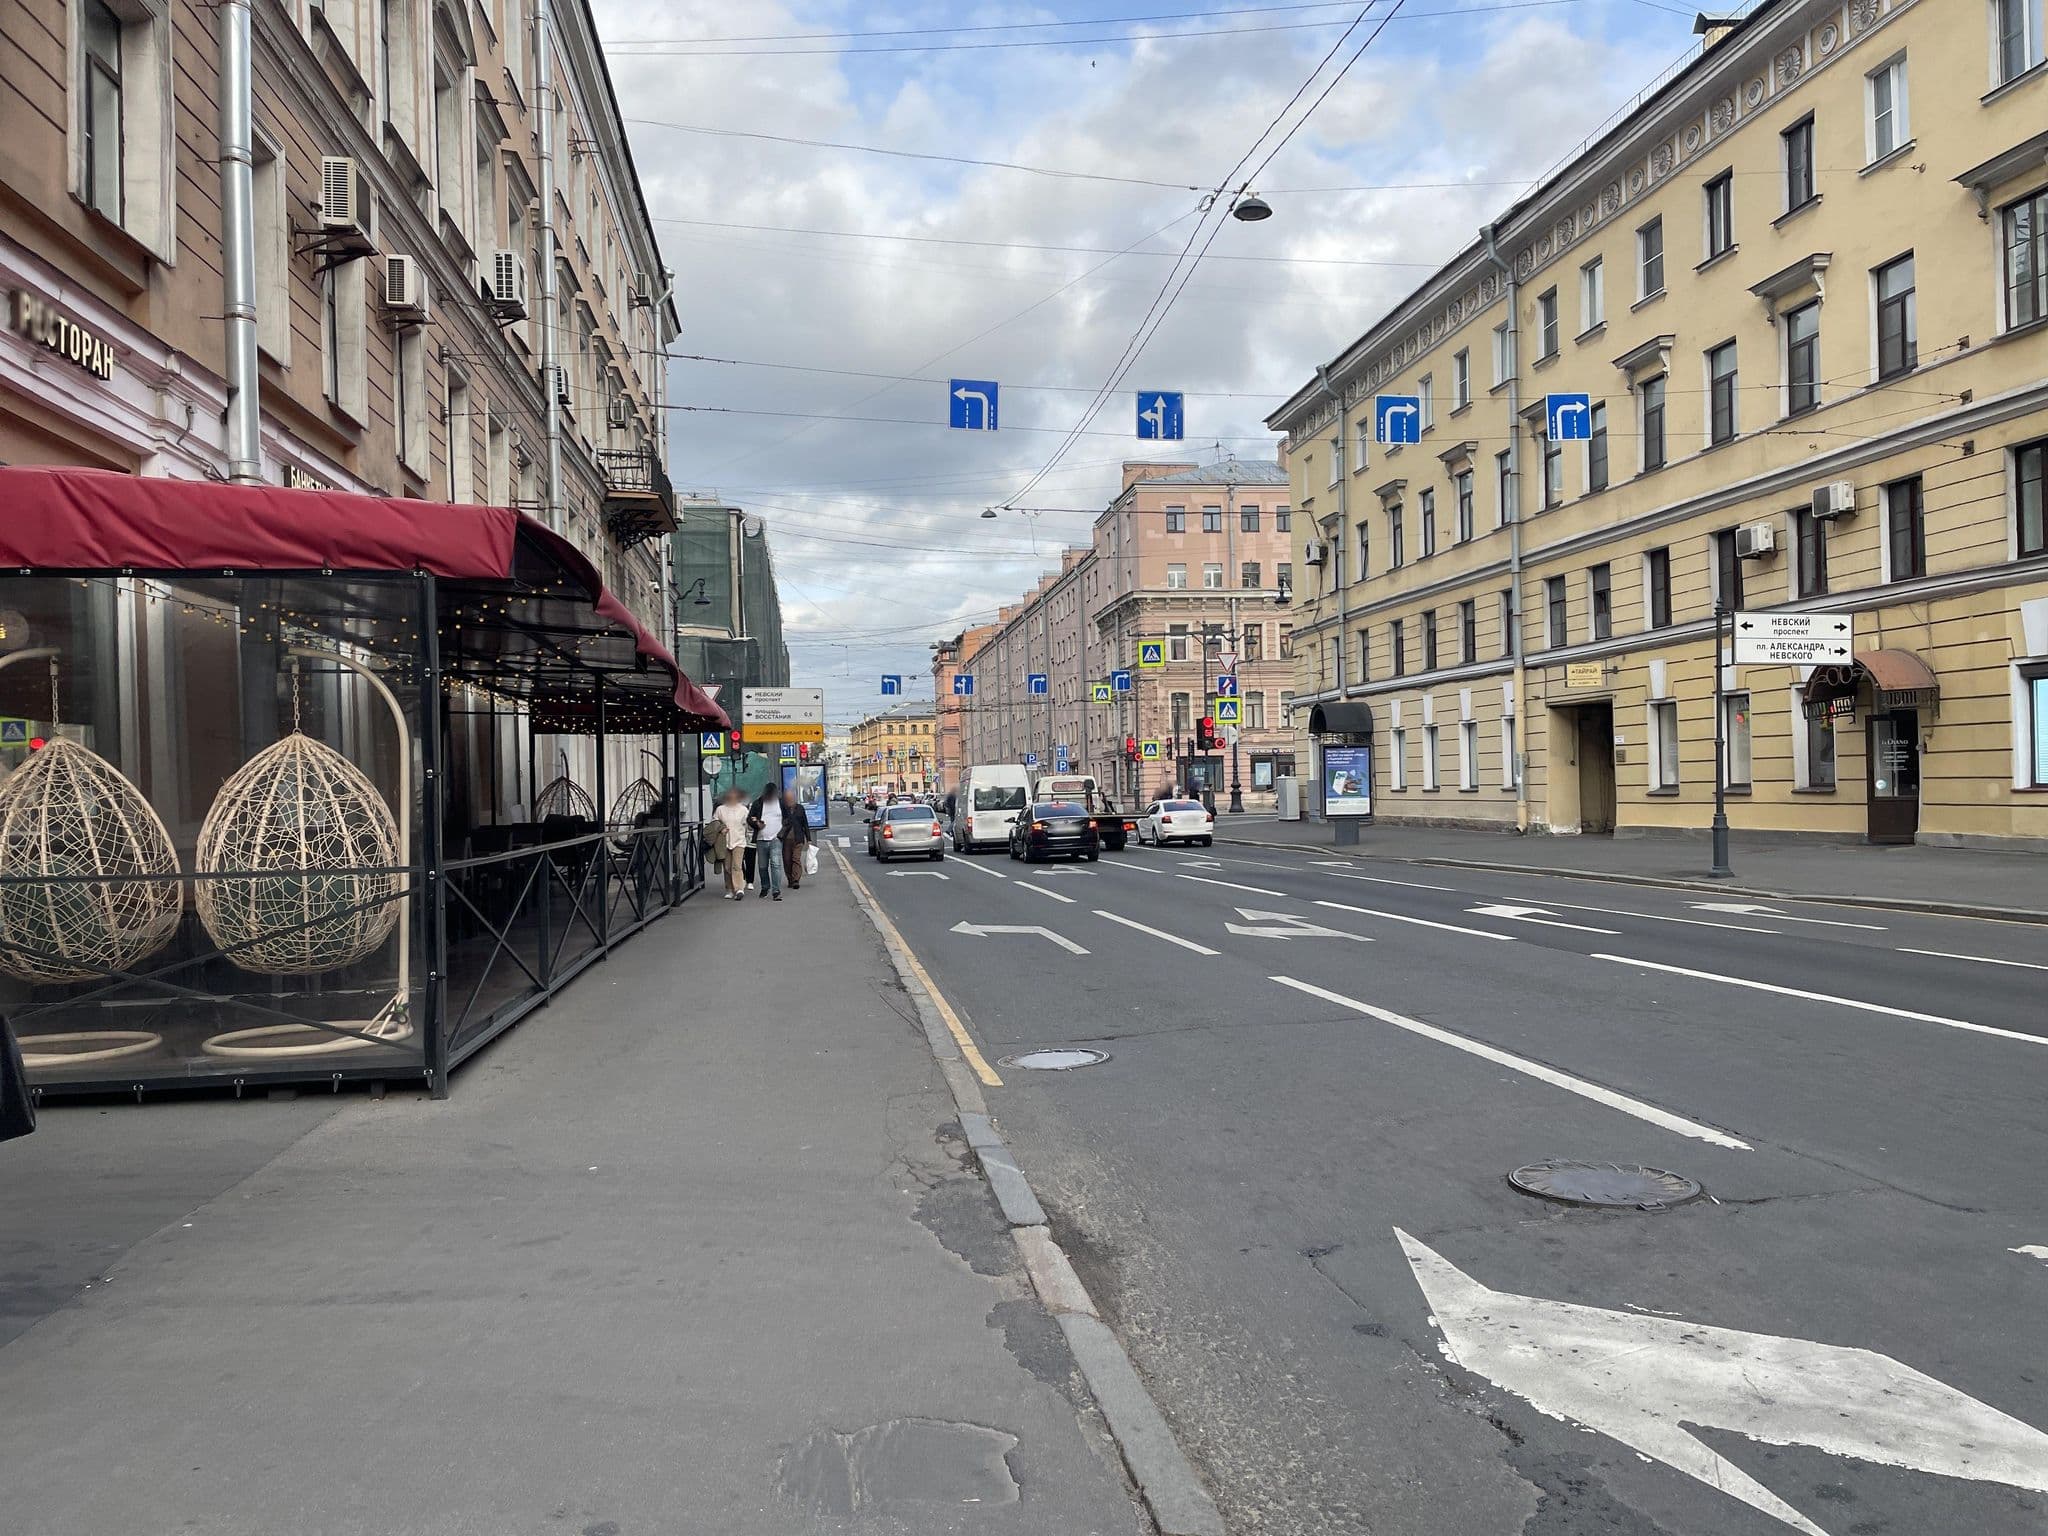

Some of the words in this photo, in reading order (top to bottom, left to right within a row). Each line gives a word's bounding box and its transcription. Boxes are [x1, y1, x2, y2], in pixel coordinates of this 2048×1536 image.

[19, 291, 114, 381] РСТОРАН
[1771, 616, 1811, 626] НЕВСКИЙ
[1770, 642, 1825, 651] АЛЕКСАНДРА
[1770, 652, 1813, 660] НЕВСКОГО
